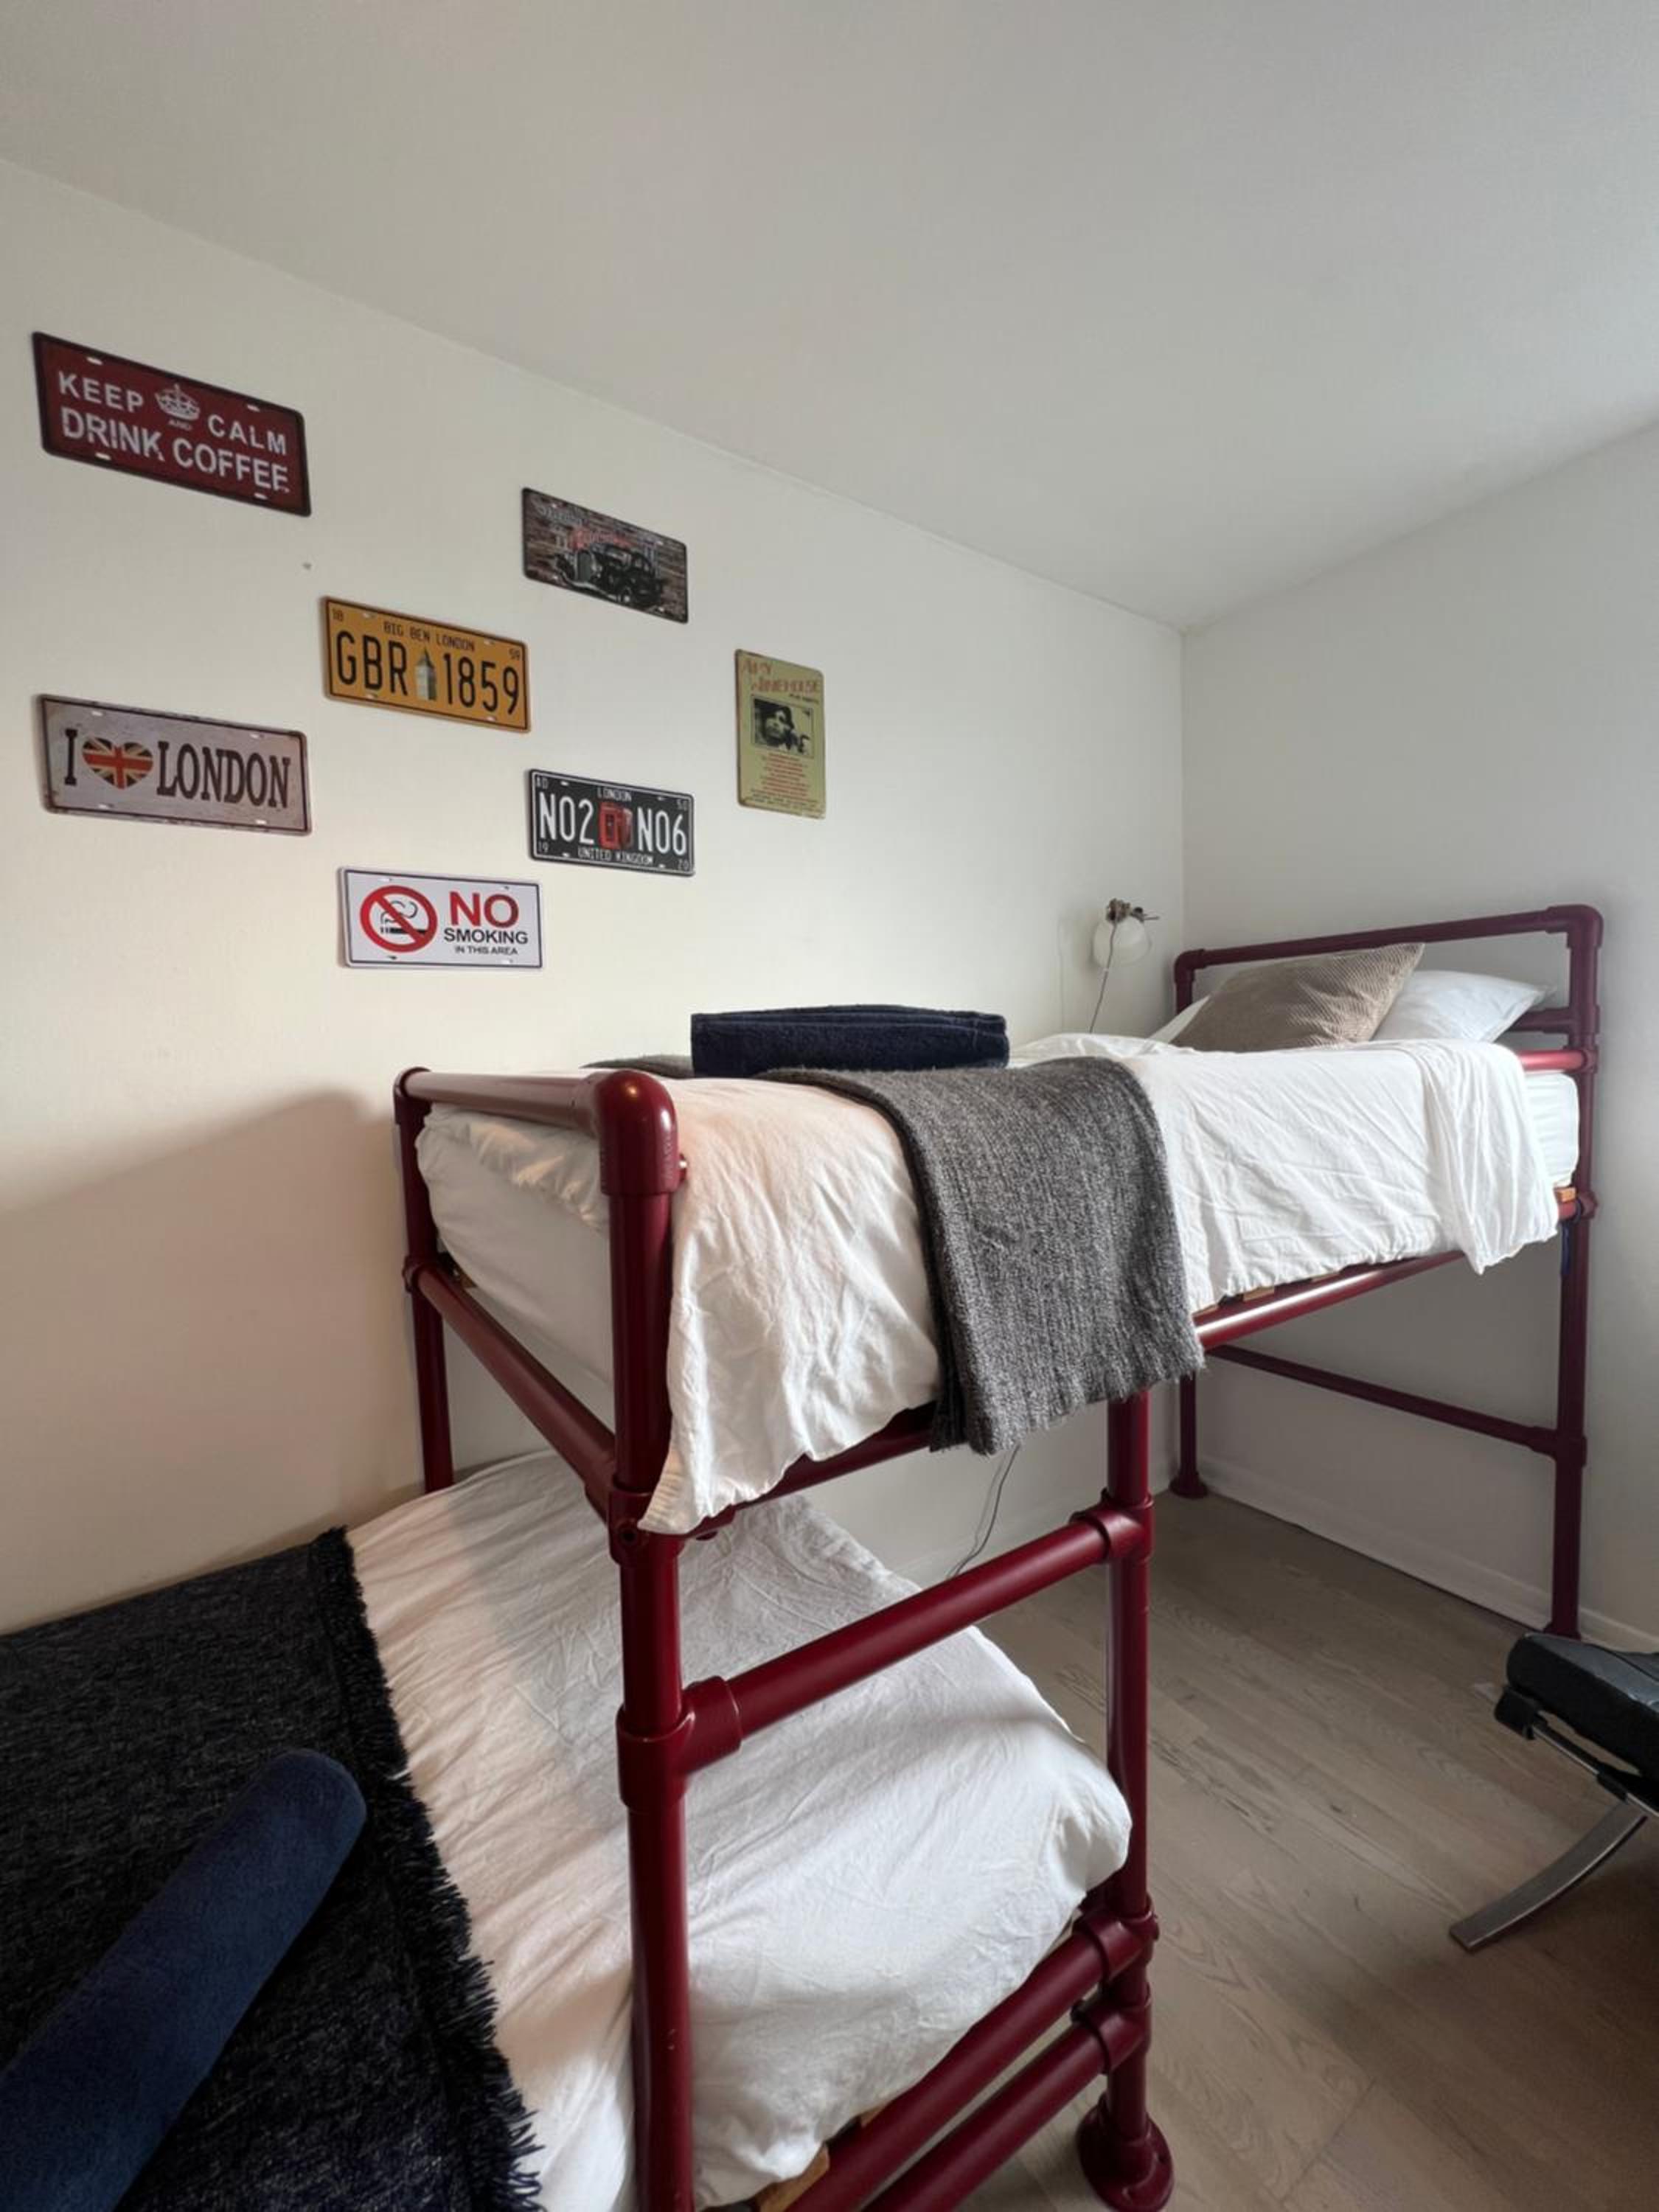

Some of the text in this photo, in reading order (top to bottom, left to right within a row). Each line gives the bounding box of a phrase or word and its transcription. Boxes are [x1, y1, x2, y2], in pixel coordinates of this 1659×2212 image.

[58, 371, 286, 456] KEEP CALM
[60, 406, 290, 493] DRINK COFFEE
[383, 622, 476, 652] BIG BEN LONDON
[335, 630, 519, 714] GBR 1859
[65, 728, 291, 808] I LONDON
[597, 787, 632, 802] LONDON
[577, 846, 654, 865] UNITED KINGDOM
[448, 890, 520, 929] NO
[443, 927, 529, 945] SMOKING
[455, 945, 518, 956] IN THIS AREA
